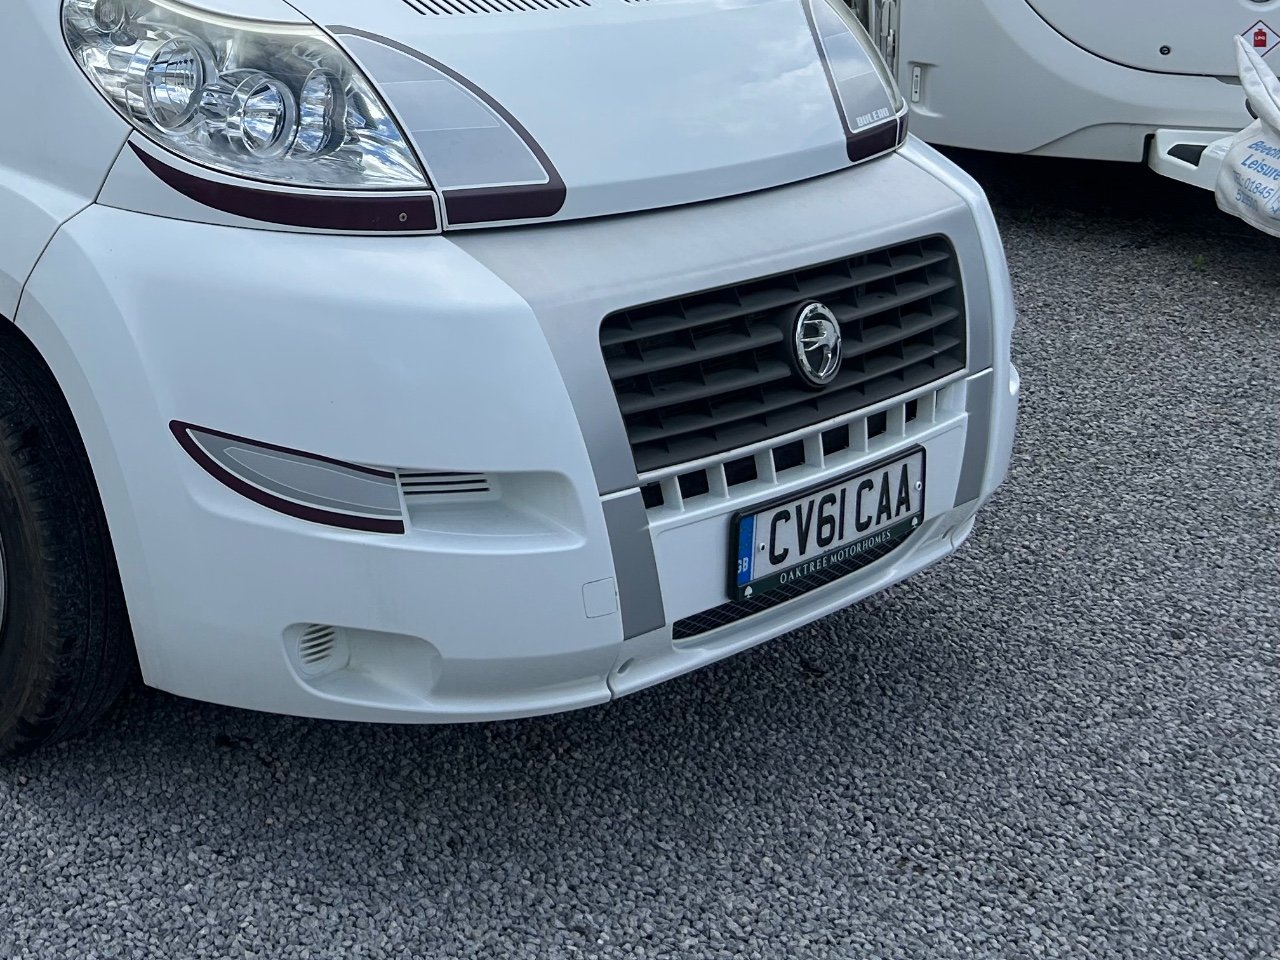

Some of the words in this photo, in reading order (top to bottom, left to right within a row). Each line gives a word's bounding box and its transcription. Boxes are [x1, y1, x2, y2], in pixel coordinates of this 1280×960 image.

[769, 488, 847, 566] CV61
[855, 463, 911, 533] CAA
[779, 557, 827, 584] OAKTREE
[830, 530, 891, 565] MOTORHOMES
